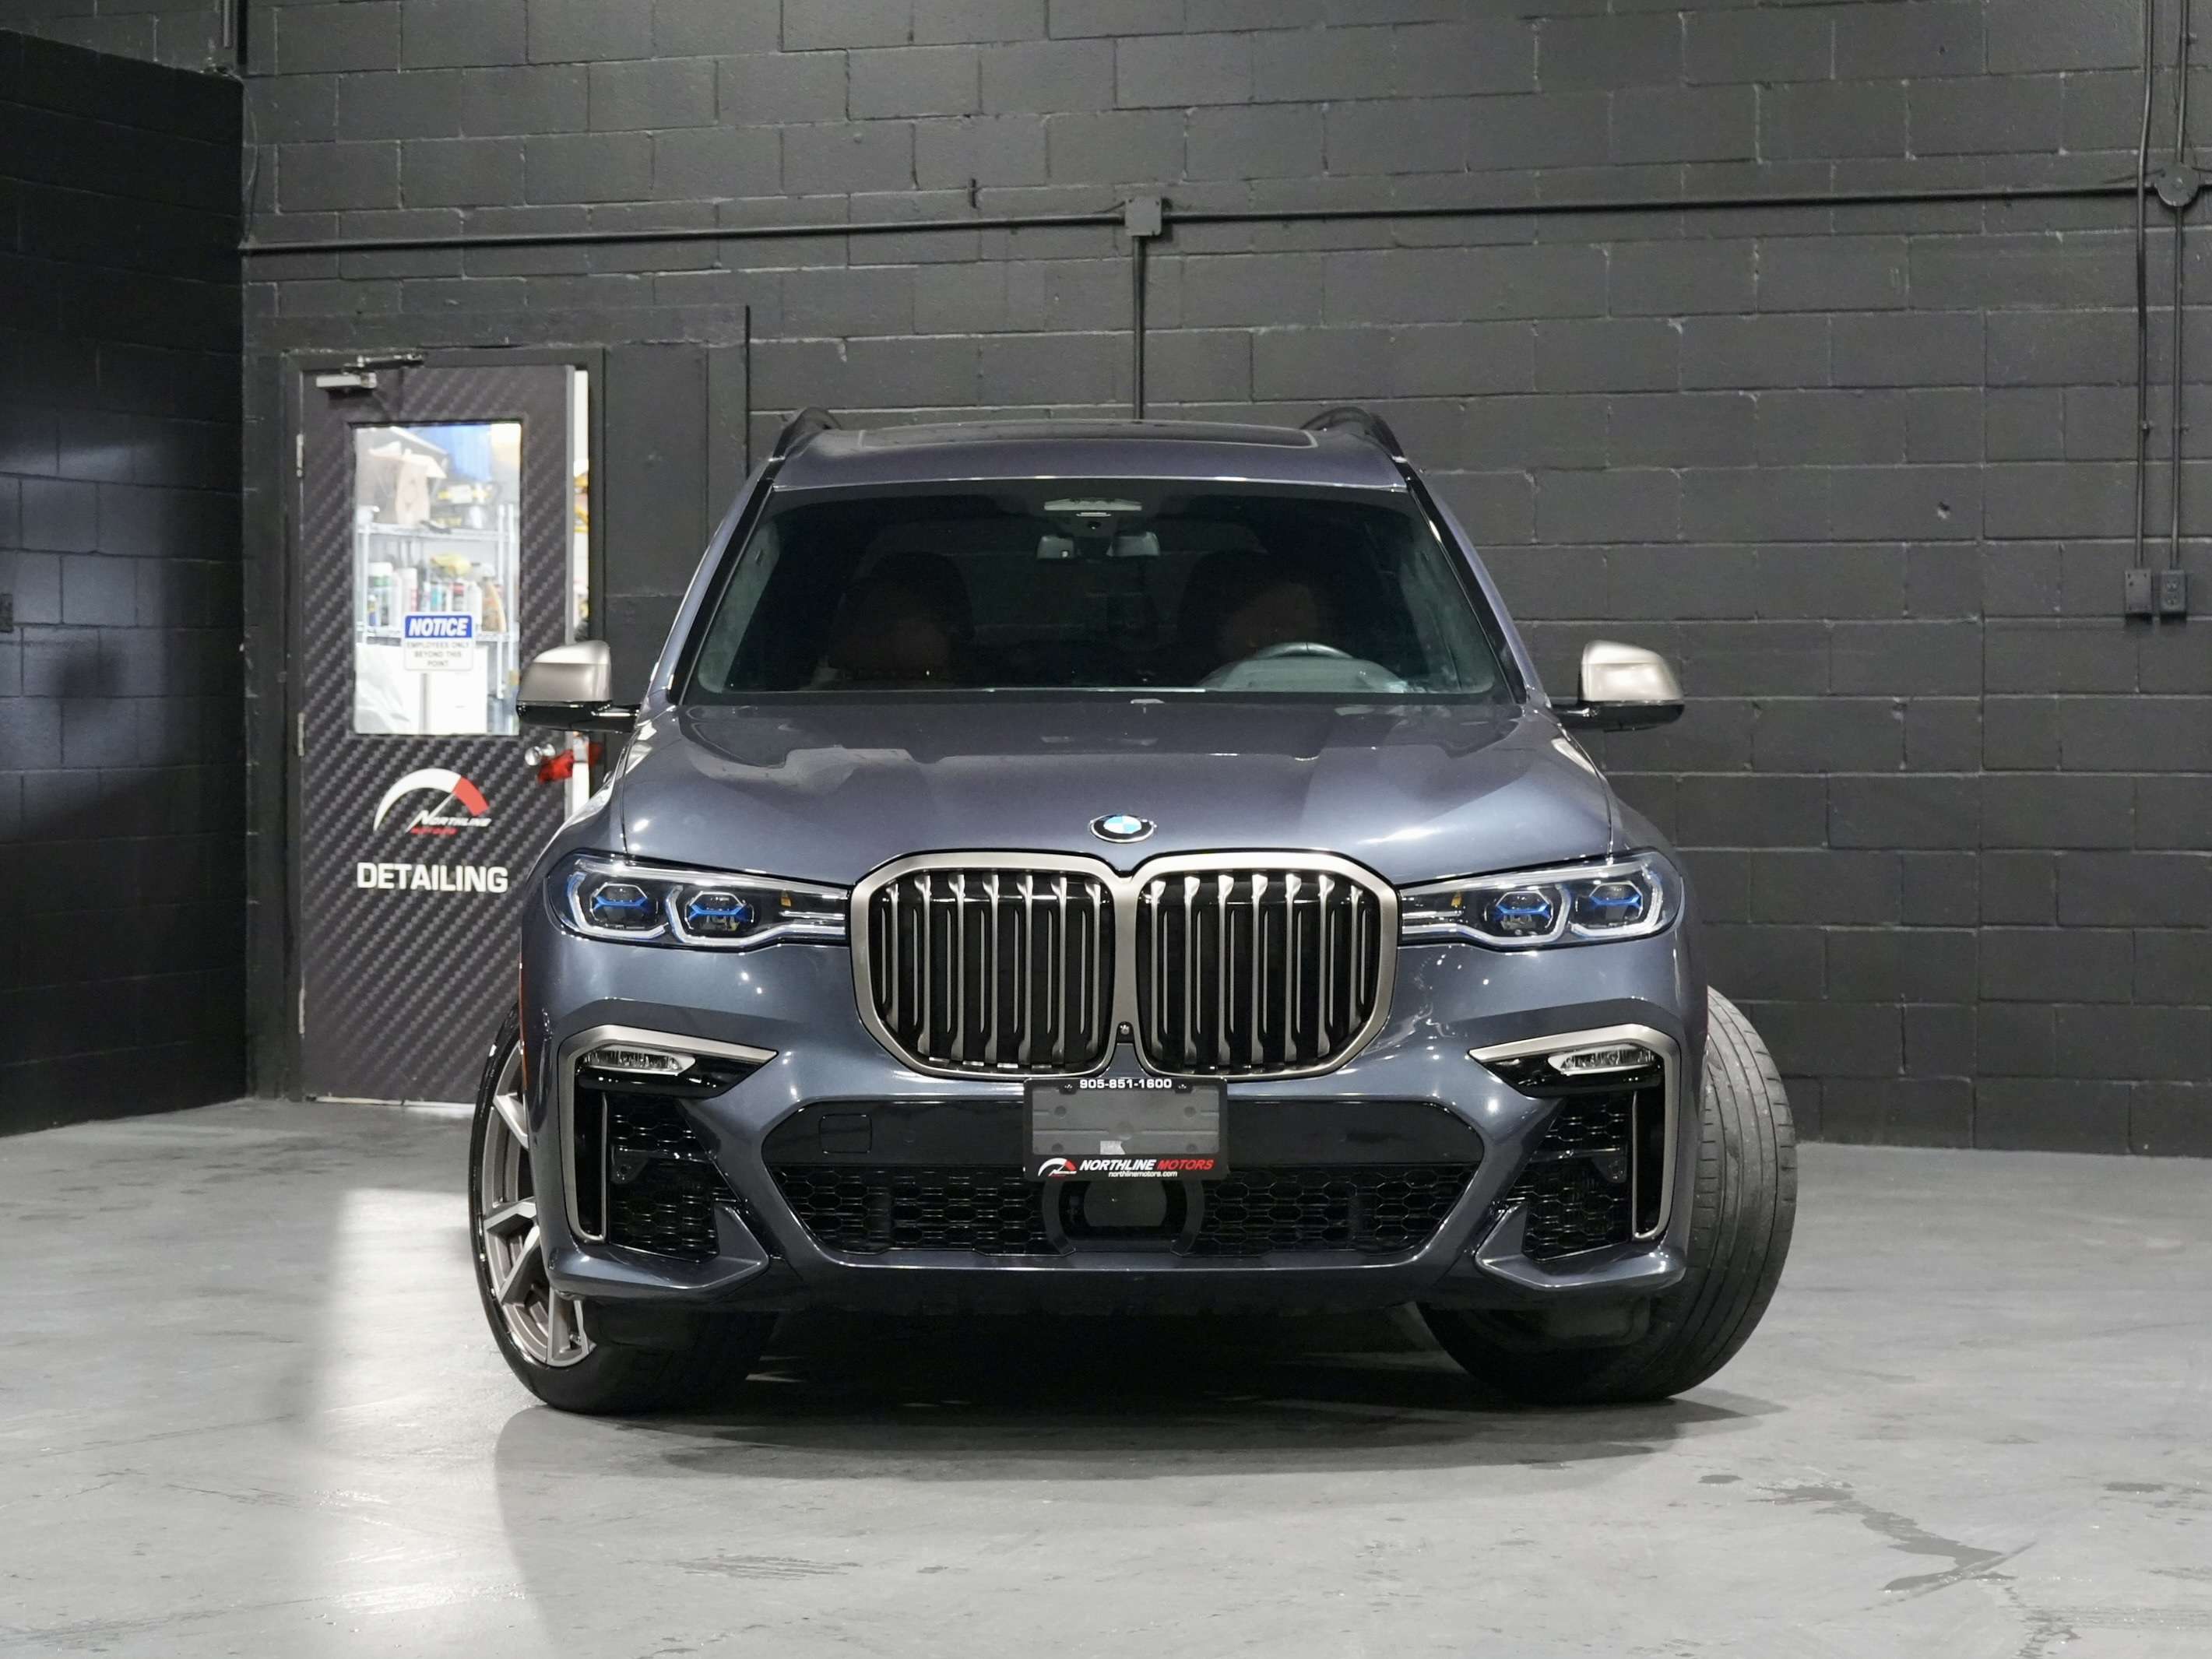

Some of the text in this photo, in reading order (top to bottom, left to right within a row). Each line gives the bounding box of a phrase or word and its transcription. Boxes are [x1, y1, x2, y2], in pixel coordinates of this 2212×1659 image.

[409, 617, 469, 636] NOTICE
[357, 862, 508, 893] DETAILING
[1079, 1078, 1172, 1088] 905-851-1600
[1079, 1159, 1214, 1171] NORTHLINE MOTORS
